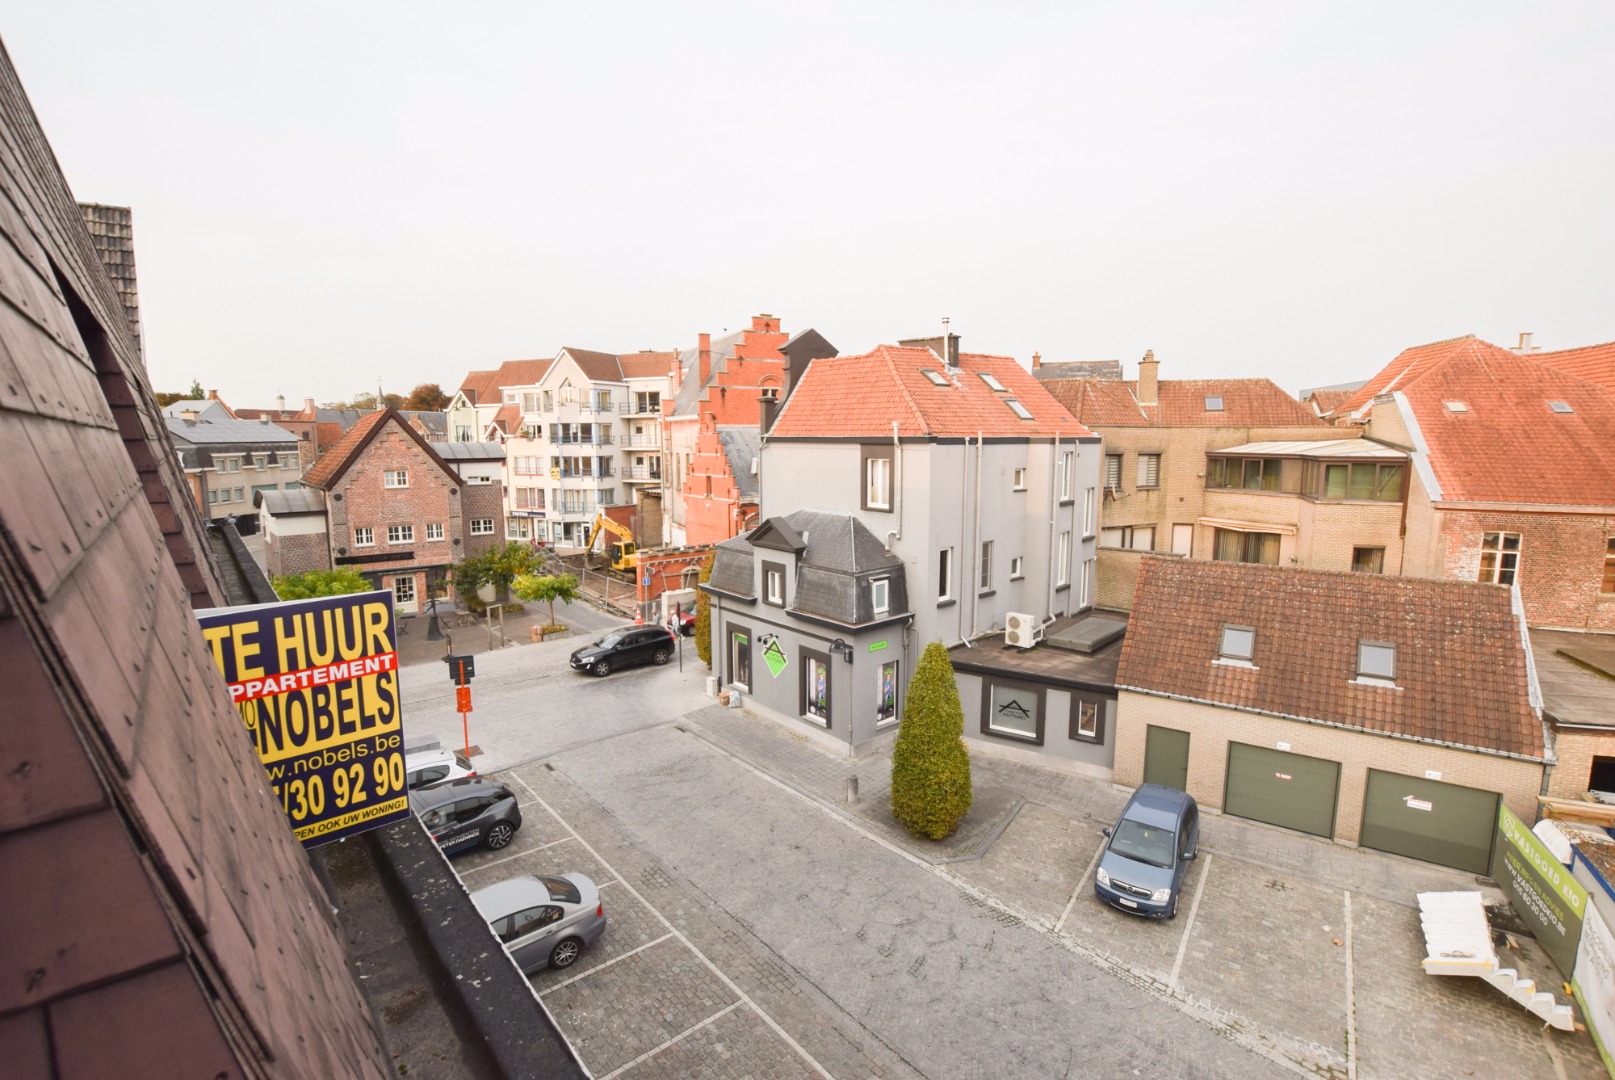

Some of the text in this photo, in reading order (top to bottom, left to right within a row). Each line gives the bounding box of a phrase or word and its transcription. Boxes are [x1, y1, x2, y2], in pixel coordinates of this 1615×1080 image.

[203, 602, 394, 682] TE HUUR
[227, 654, 395, 701] PPARTEMENT
[257, 670, 395, 756] NOBELS
[266, 734, 401, 781] w.nobels.be
[333, 763, 367, 808] 92
[373, 752, 404, 796] 90
[295, 800, 404, 838] PEN OOK UW WONING!
[1513, 830, 1580, 907] VASTGOED KIO
[1539, 913, 1549, 926] 00
